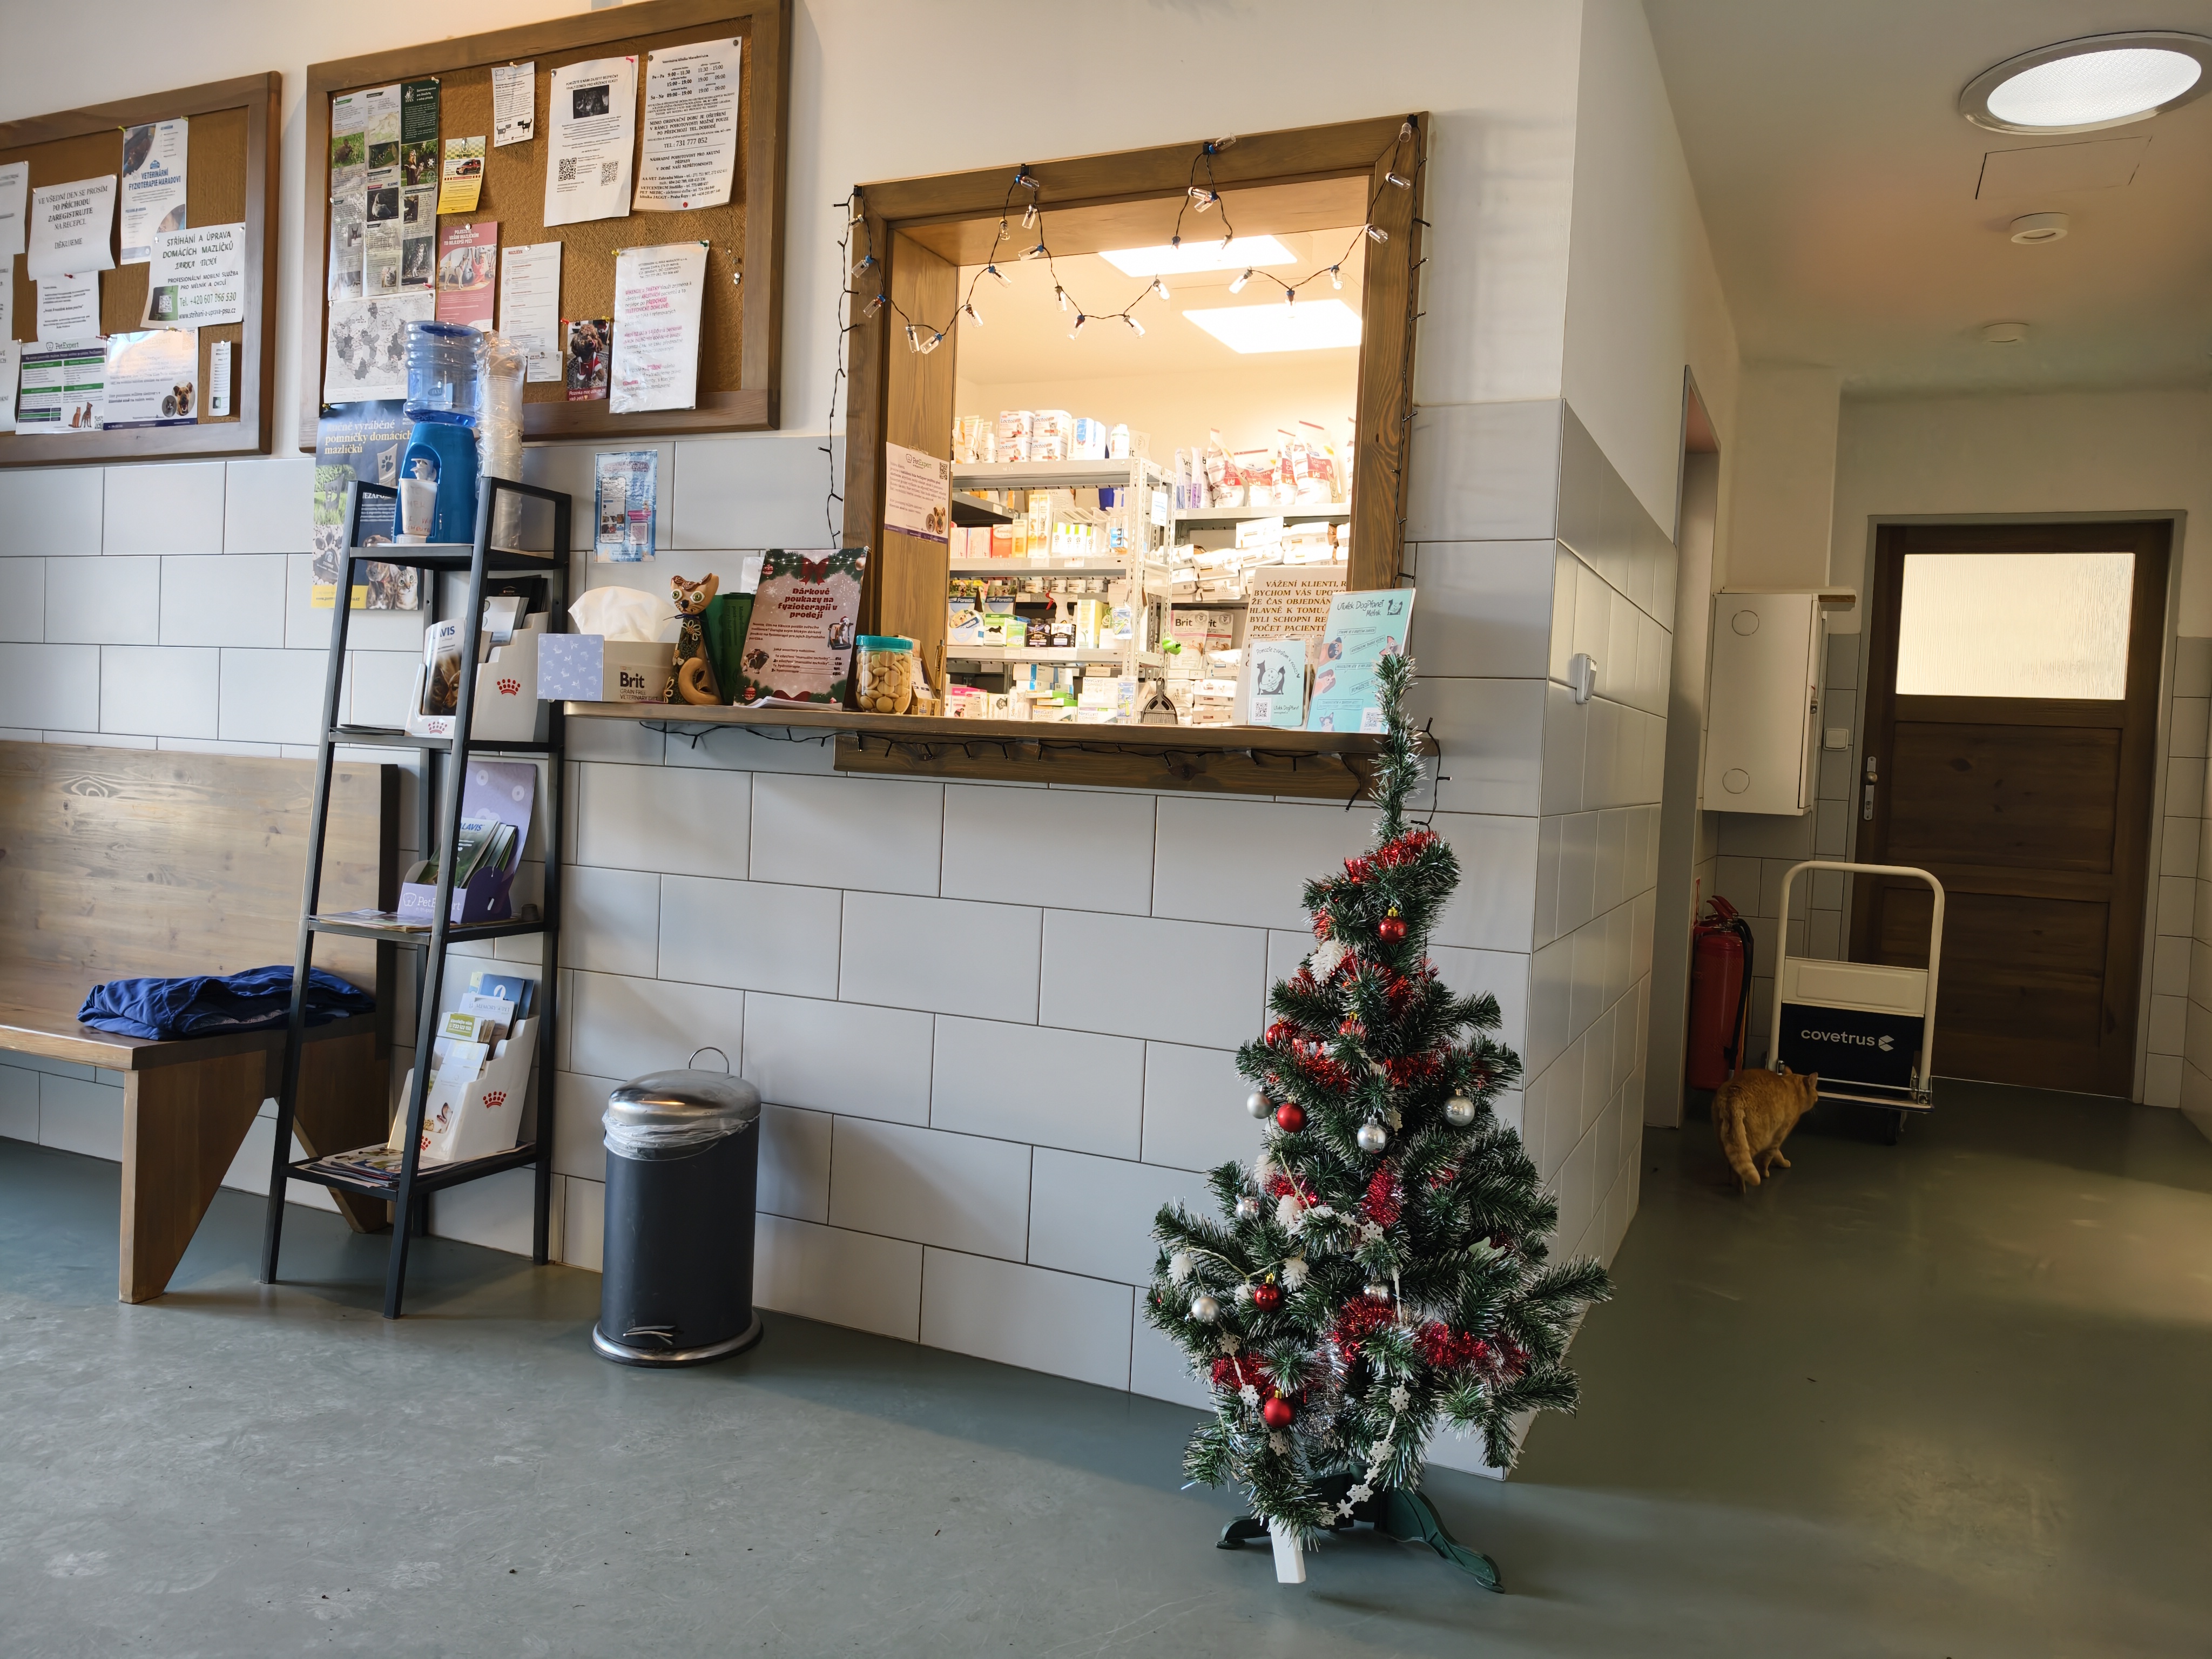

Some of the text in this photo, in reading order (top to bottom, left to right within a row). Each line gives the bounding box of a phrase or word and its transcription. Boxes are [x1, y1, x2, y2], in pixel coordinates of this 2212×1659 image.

[46, 192, 65, 203] VŠEDNÍ
[87, 185, 107, 194] PROSÍM
[61, 198, 90, 210] PŘÍCHODU
[49, 207, 93, 222] ZAREGISTRUJTE
[55, 238, 82, 249] DĚKUJEME
[167, 234, 195, 246] STŘÍHÁNÍ
[207, 231, 231, 241] ÚPRAVA
[163, 241, 233, 258] DOMÁCÍCH MAZLÍČKŮ
[168, 275, 201, 283] PROFESIONÁLNÍ
[180, 297, 188, 307] Tel.
[190, 295, 203, 305] +420
[204, 294, 213, 304] 607
[226, 292, 237, 301] 530
[355, 419, 395, 431] vyráběné
[325, 432, 368, 446] pomníčky
[325, 444, 362, 454] mazlíčků
[913, 457, 932, 469] PetExpert
[778, 603, 831, 611] fyzioterapii
[620, 672, 645, 688] Brit
[1801, 1030, 1875, 1046] covetrus
